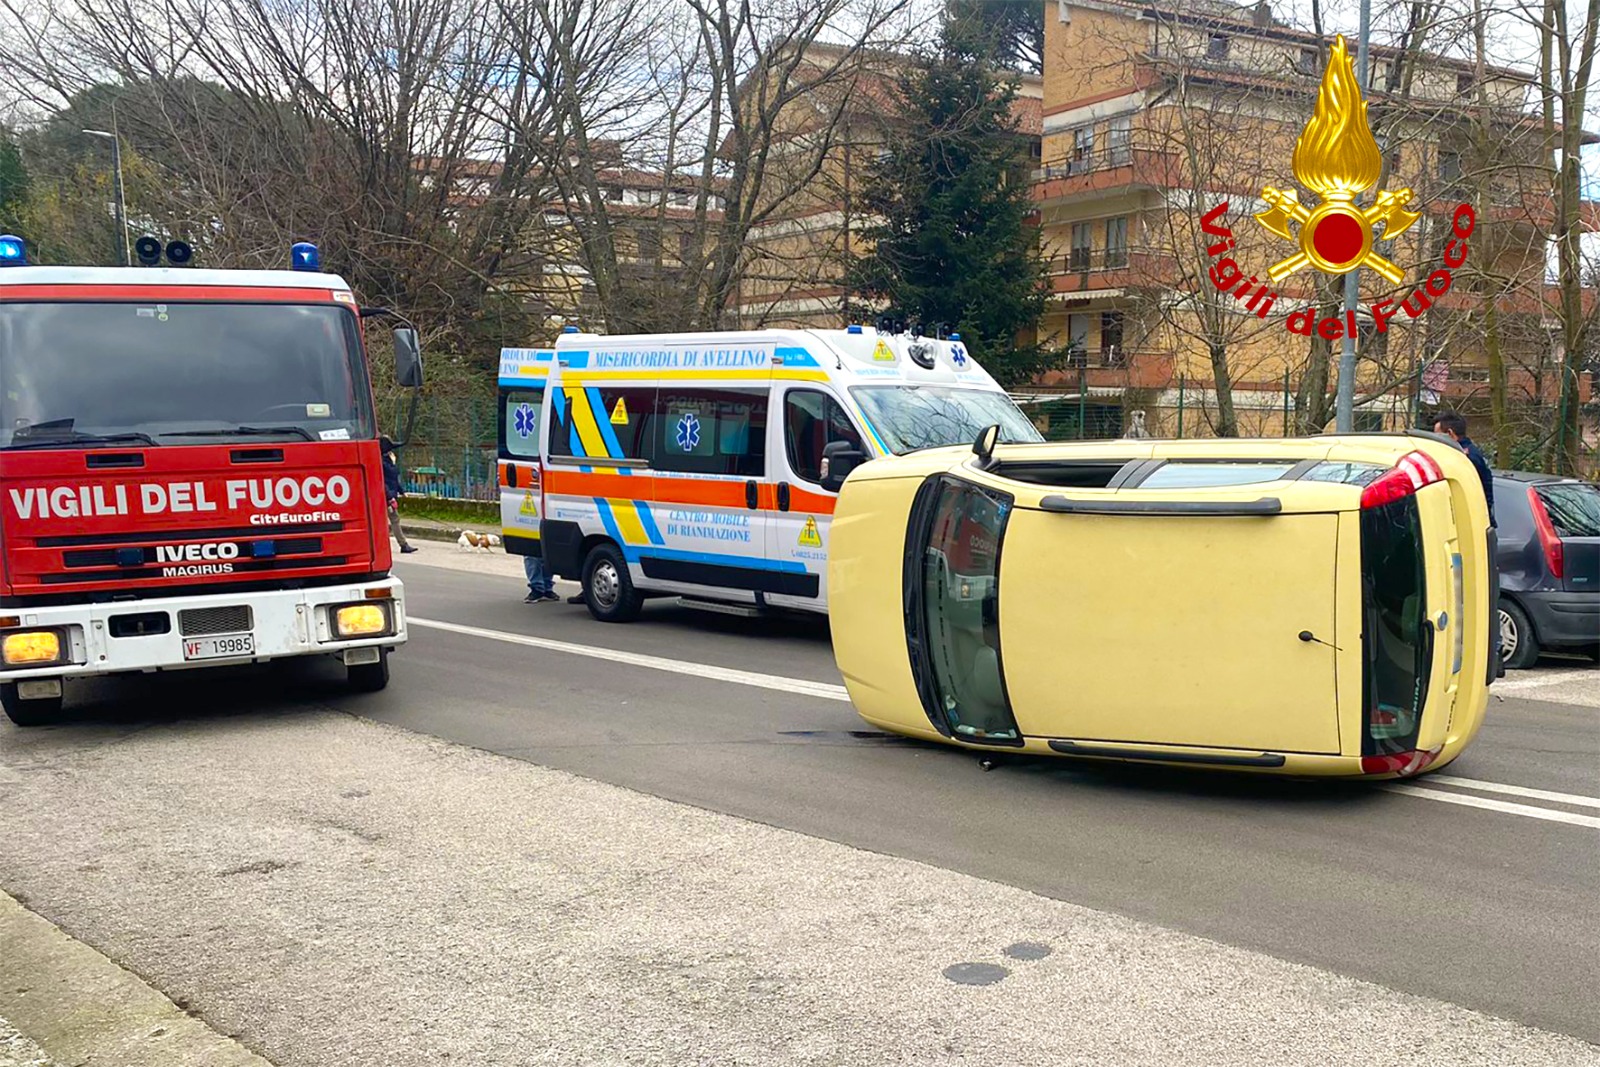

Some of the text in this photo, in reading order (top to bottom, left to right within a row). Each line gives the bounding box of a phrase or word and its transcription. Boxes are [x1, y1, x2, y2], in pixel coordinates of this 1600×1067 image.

[595, 350, 766, 368] MISERICORDIA DI AVELLINO
[9, 475, 350, 519] VIGILI DEL FUOCO
[250, 512, 340, 525] CityEuroFire
[669, 510, 750, 527] CENTRO MOBILE
[667, 524, 751, 542] DI RIANIMAZIONE
[156, 542, 239, 563] IVECO
[162, 563, 234, 577] MAGIRUS
[186, 638, 251, 656] VF 19985
